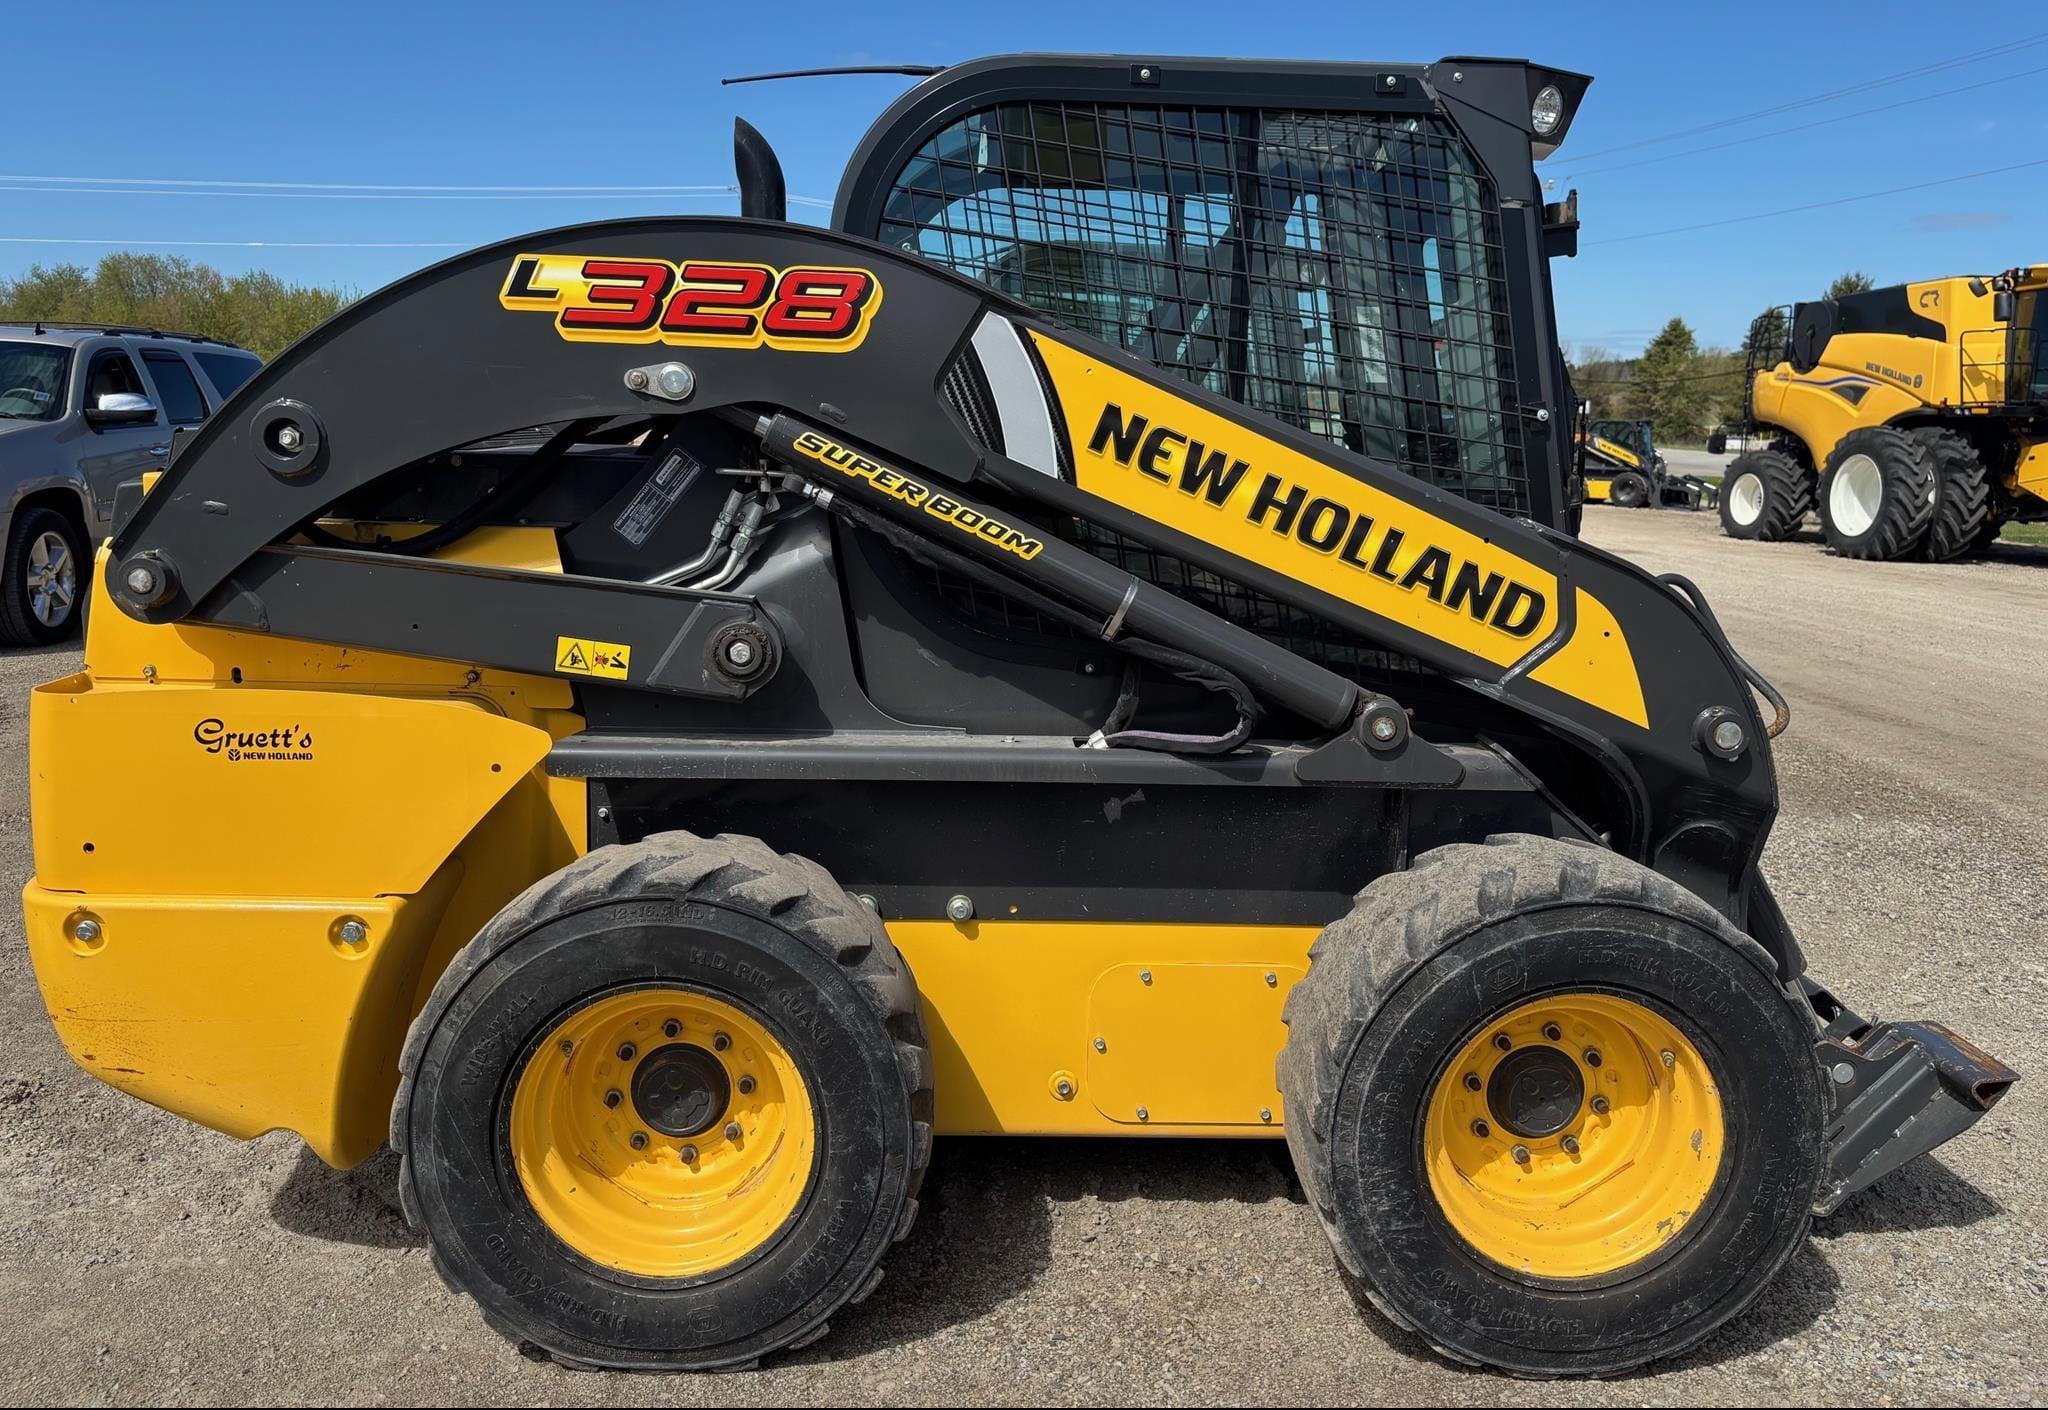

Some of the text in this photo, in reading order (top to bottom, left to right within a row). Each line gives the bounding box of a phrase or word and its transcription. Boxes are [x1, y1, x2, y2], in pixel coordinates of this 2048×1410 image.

[797, 432, 1043, 557] SUPER BOOM
[1087, 402, 1546, 638] NEW HOLLAND
[194, 718, 312, 753] Gruett's
[243, 752, 313, 761] NEW HOLLAND
[690, 947, 731, 973] H.D.
[735, 960, 775, 993] RIM
[778, 988, 835, 1050] GUARD
[486, 1234, 543, 1291] GUARD
